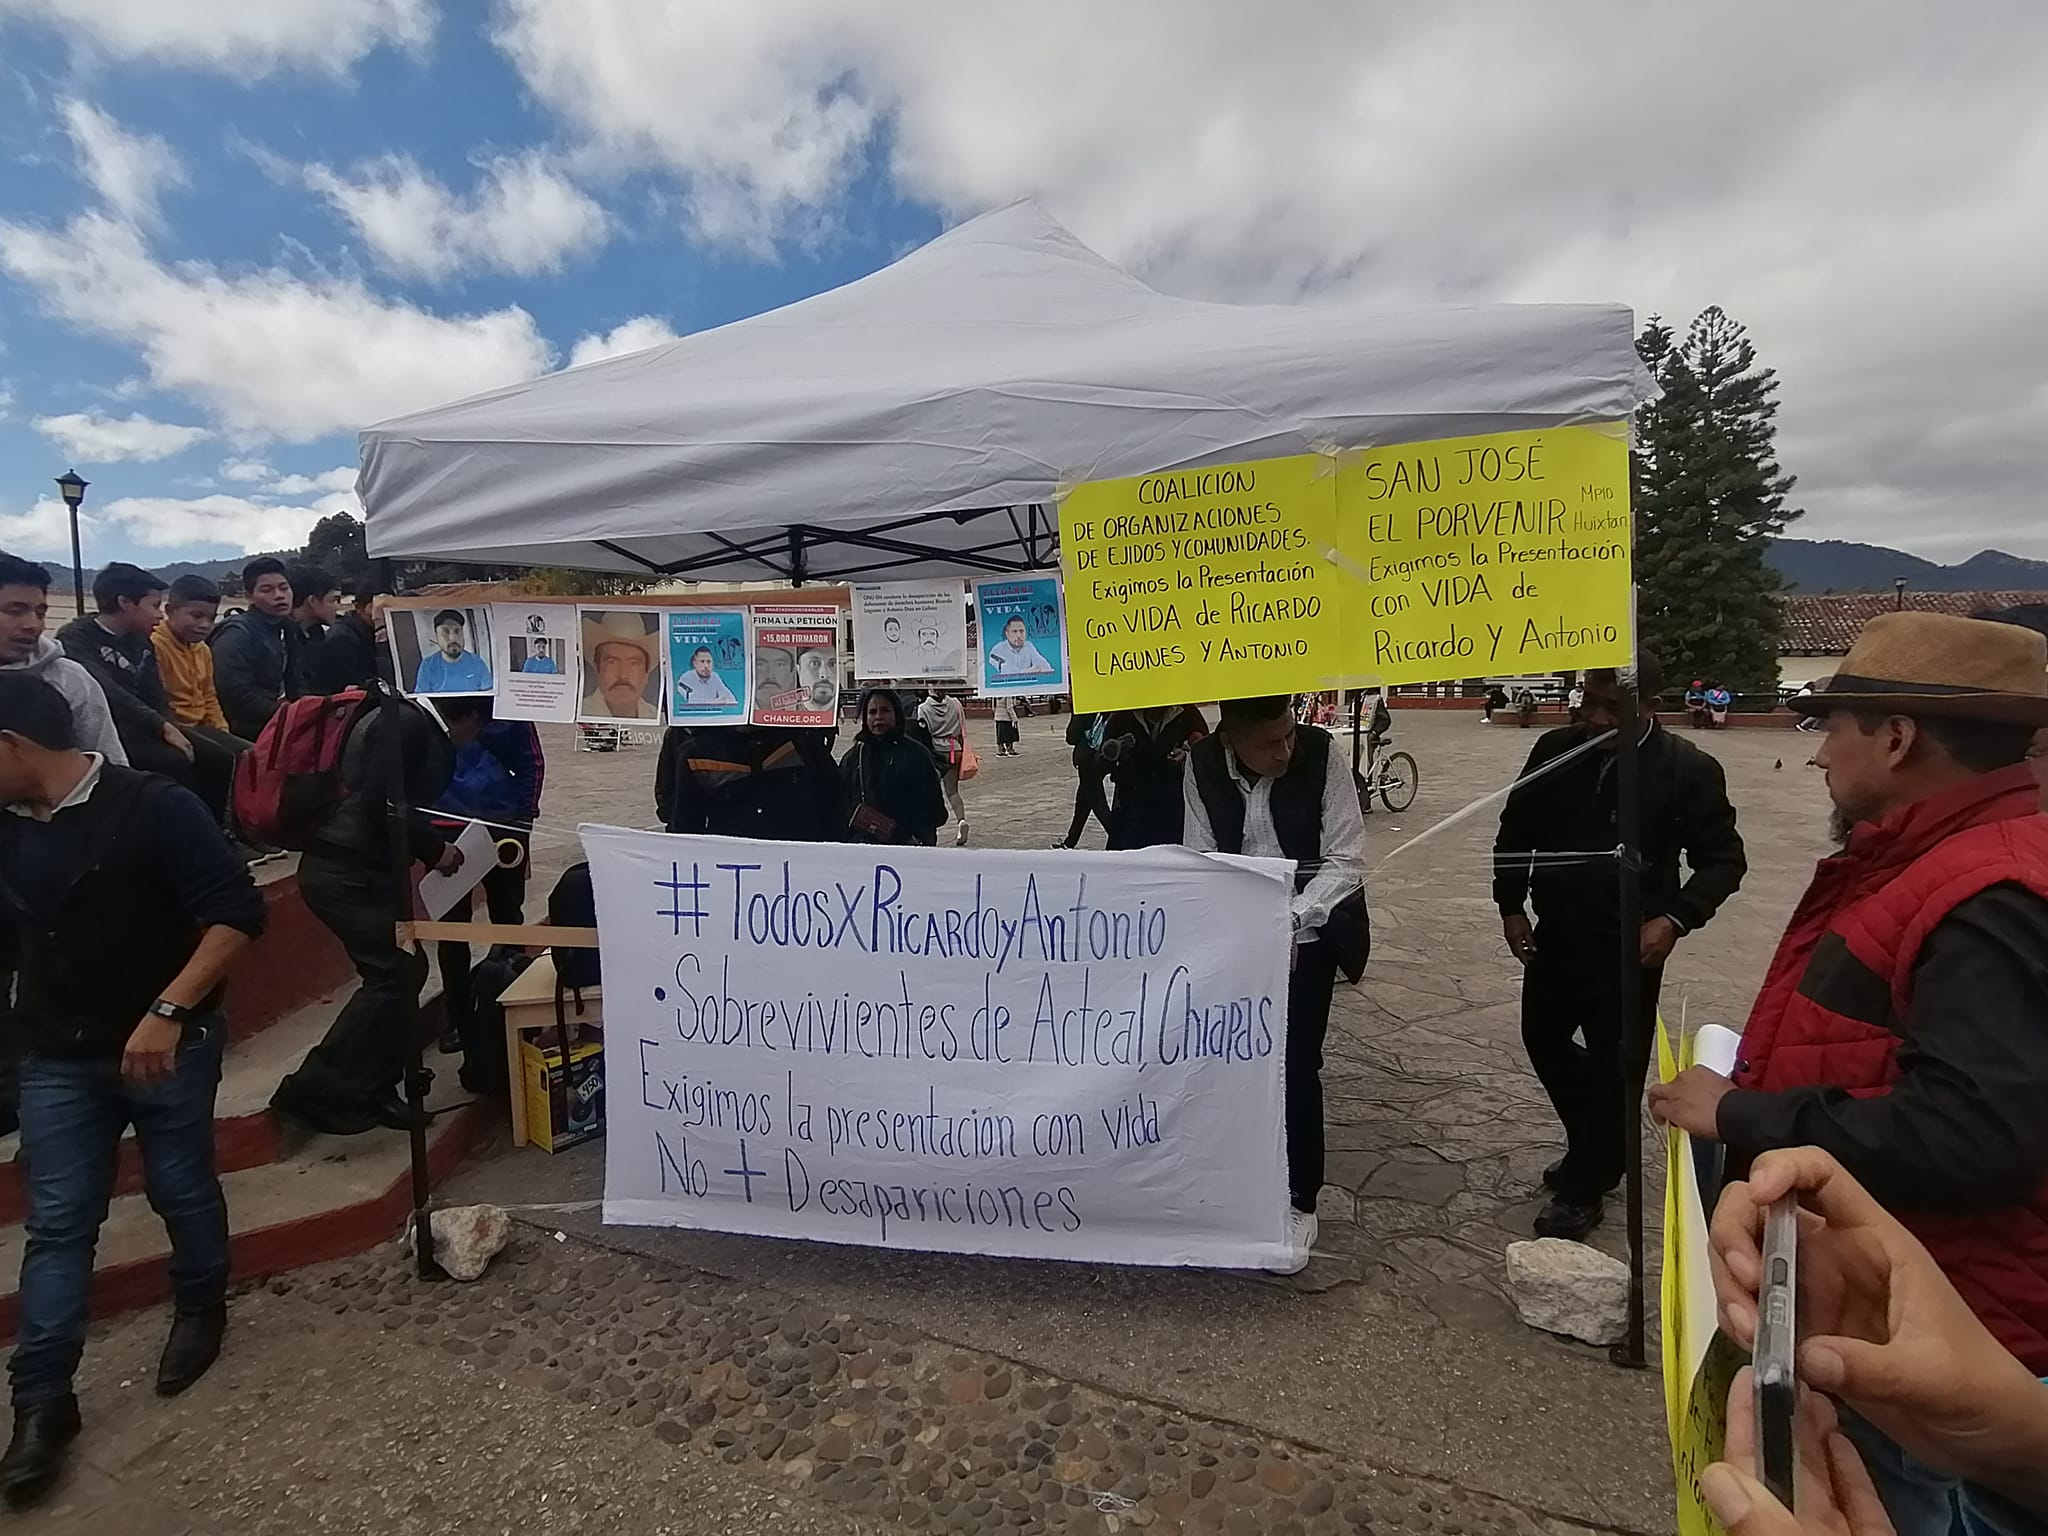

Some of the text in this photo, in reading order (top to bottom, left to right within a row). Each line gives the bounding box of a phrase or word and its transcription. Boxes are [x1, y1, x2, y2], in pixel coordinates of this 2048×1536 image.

[1139, 470, 1256, 505] COALICION
[1366, 438, 1545, 500] SAN JOSÉ
[1073, 502, 1281, 542] DE ORGANIZACIONES
[1369, 499, 1566, 543] EL PORVENIR
[1077, 549, 1099, 571] DE
[1108, 542, 1166, 566] EJIDOS
[1369, 538, 1625, 582] Exigimos la Presentación
[1092, 560, 1314, 605] Exigimos la Presentación
[1421, 574, 1493, 607] VIDA
[1512, 571, 1538, 599] de
[752, 615, 838, 625] FIRMA LA PETICIÓN
[1122, 604, 1182, 633] VIDA
[1196, 599, 1221, 626] de
[1231, 591, 1321, 624] RICARDO
[791, 633, 829, 644] FIRMARON
[1374, 623, 1474, 665] Ricardo
[1519, 615, 1617, 654] Antonio
[1094, 645, 1186, 676] LAGUNES
[763, 714, 822, 723] CHANGE.ORG
[675, 953, 957, 1061] Sobrevivientes
[971, 972, 1011, 1063] de
[640, 1039, 771, 1136] Exigimos
[787, 1070, 813, 1142] la
[1032, 1113, 1085, 1157] con
[1101, 1092, 1161, 1149] vida
[655, 1130, 1082, 1242] No + Desapariciones
